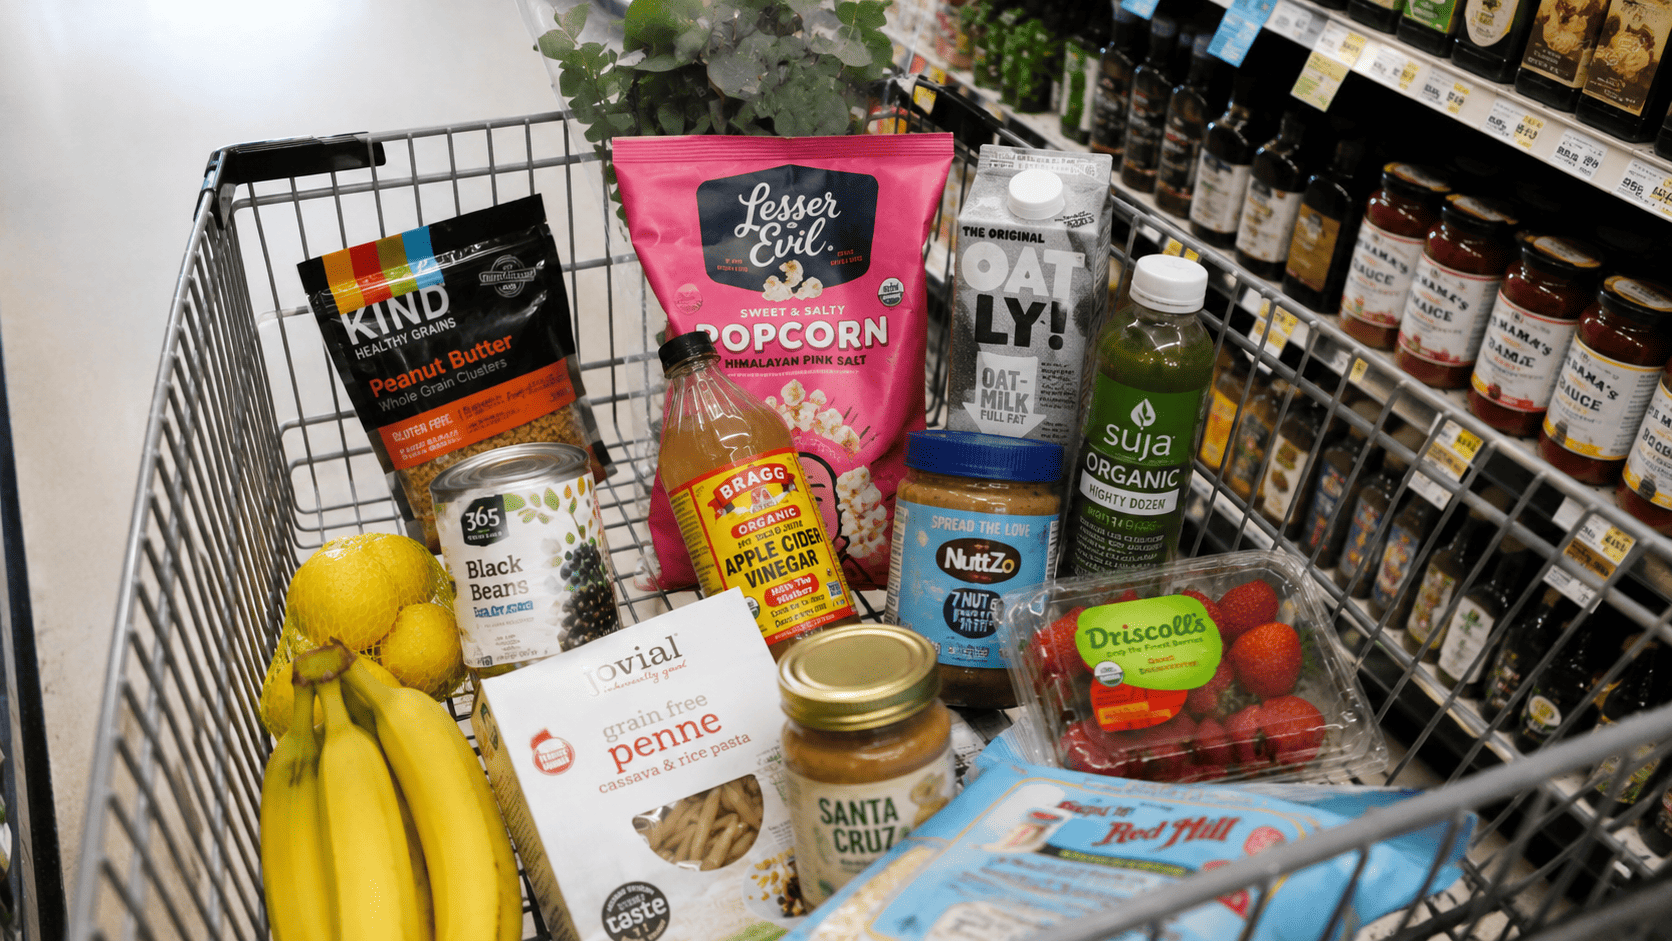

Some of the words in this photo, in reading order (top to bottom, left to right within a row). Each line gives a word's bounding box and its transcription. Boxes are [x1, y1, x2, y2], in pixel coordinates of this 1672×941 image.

[734, 182, 841, 238] Lesser
[962, 225, 985, 238] THE
[988, 228, 1045, 243] ORIGINAL
[961, 241, 1086, 302] OAT
[340, 284, 450, 345] KIND
[740, 306, 786, 319] SWEET
[790, 308, 800, 317] &
[804, 304, 846, 316] SALTY
[974, 293, 1068, 351] LY!
[354, 333, 408, 361] HEALTHY
[411, 317, 457, 341] GRAINS
[369, 357, 446, 397] Peanut
[451, 332, 514, 370] Butter
[724, 356, 800, 369] HIMALAYAN
[802, 353, 833, 366] PINK
[837, 354, 867, 367] SALT
[981, 366, 1028, 391] OAT-
[378, 389, 419, 412] Whole
[420, 375, 456, 398] Grain
[456, 357, 508, 383] Clusters
[980, 409, 1006, 422] FULL
[1007, 412, 1027, 425] FAT
[1103, 423, 1172, 462] suja
[719, 466, 786, 500] BRAGG
[1086, 451, 1180, 489] ORGANIC
[465, 505, 501, 531] 365
[739, 508, 797, 535] ORGANIC
[1129, 497, 1167, 511] DOZEN
[931, 515, 975, 533] SPREAD
[979, 519, 1001, 535] THE
[1004, 522, 1031, 538] LOVE
[465, 554, 524, 580] Black
[725, 540, 779, 577] APPLE
[781, 527, 823, 553] CIDER
[744, 549, 820, 589] VINEGAR
[944, 547, 1015, 573] NuttZo
[470, 579, 530, 602] Beans
[951, 591, 961, 607] 7
[961, 592, 990, 609] NUT
[1085, 613, 1206, 649] Driscoll's
[584, 635, 682, 697] jovial
[602, 706, 664, 743] grain
[666, 693, 709, 718] free
[607, 712, 723, 775] penne
[598, 766, 661, 794] cassava
[663, 758, 676, 773] &
[678, 747, 709, 767] rice
[712, 731, 752, 758] pasta
[819, 796, 900, 827] SANTA
[832, 825, 896, 854] CRUZ
[606, 897, 668, 934] taste
